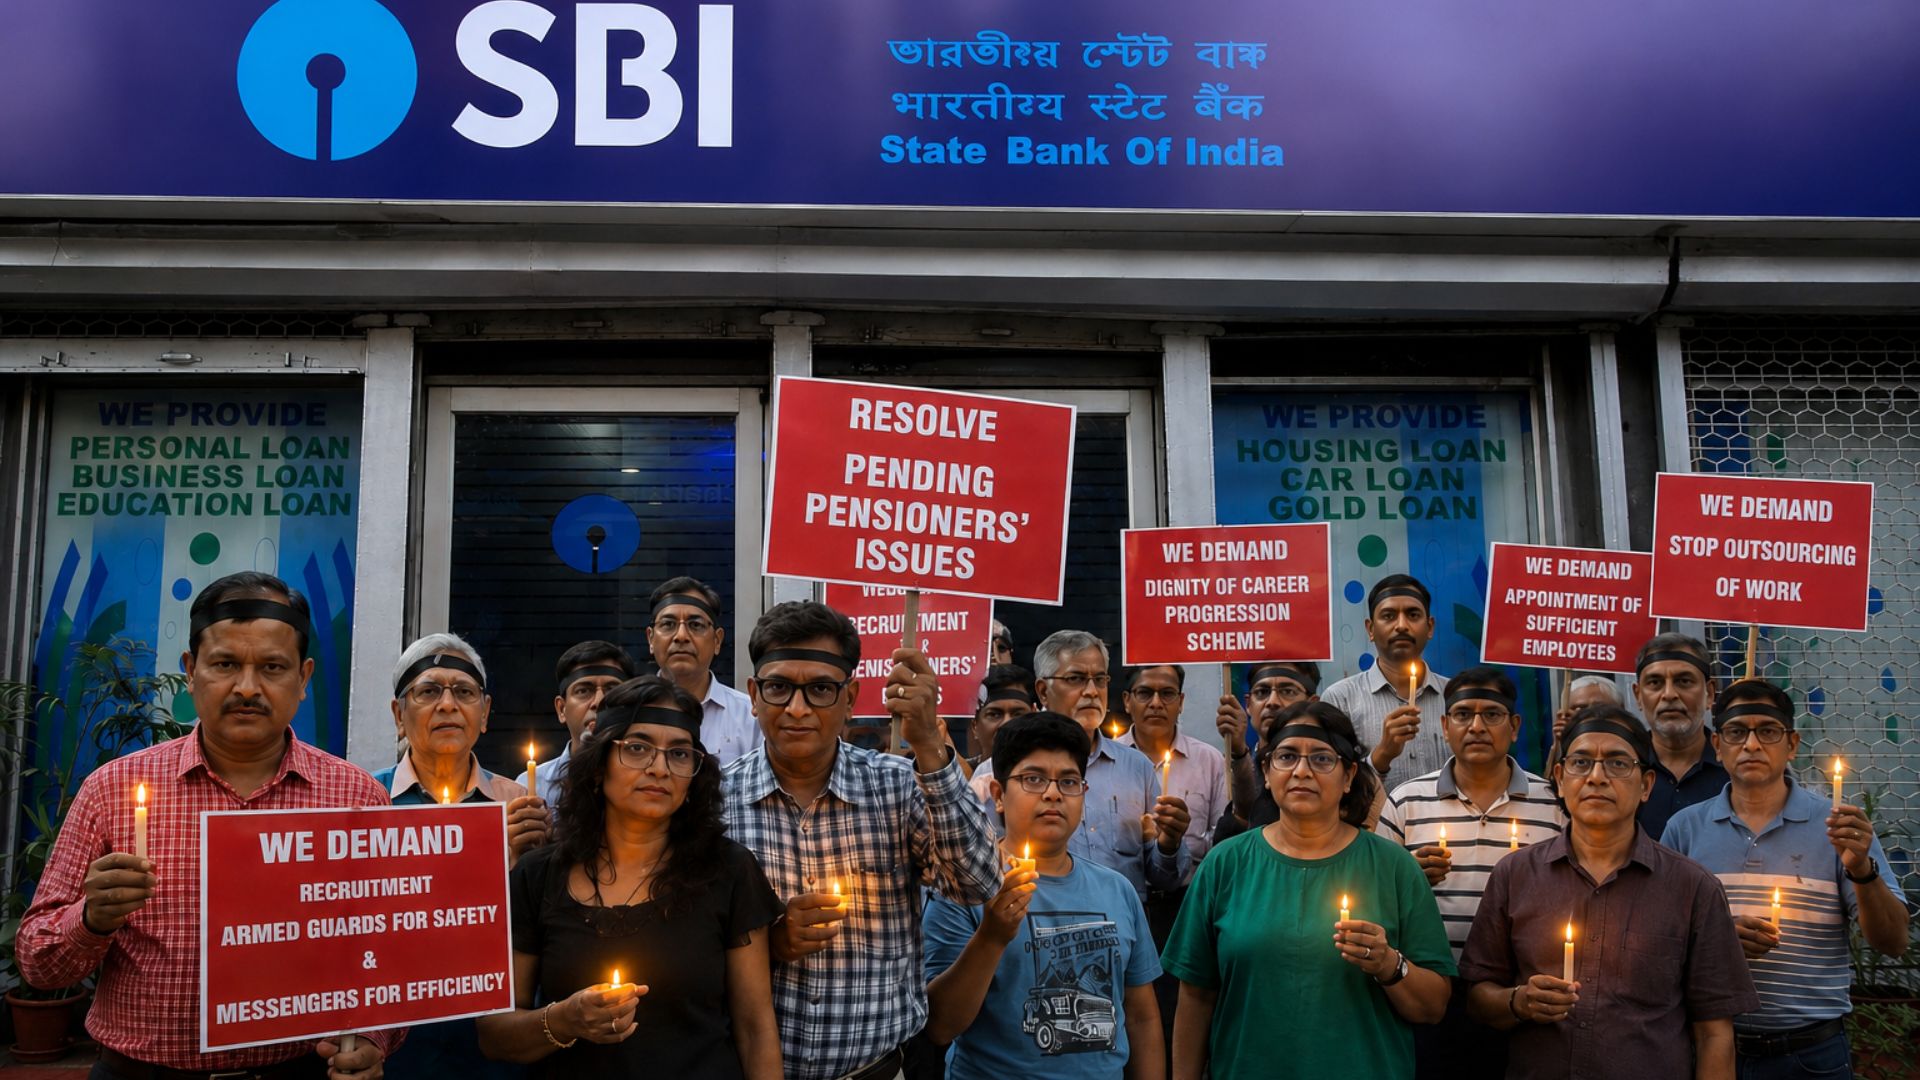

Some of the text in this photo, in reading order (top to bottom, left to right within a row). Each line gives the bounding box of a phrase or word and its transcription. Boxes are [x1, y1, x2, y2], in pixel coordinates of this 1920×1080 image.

[452, 0, 734, 148] SBI
[881, 136, 1283, 165] State Bank Of India
[99, 403, 326, 425] WE PROVIDE
[849, 397, 998, 442] RESOLVE
[1263, 405, 1487, 428] WE PROVIDE
[70, 437, 349, 459] PERSONAL LOAN
[1237, 439, 1506, 463] HOUSING LOAN
[72, 465, 344, 488] BUSINESS LOAN
[844, 453, 995, 498] PENDING
[1280, 467, 1464, 491] CAR LOAN
[57, 493, 350, 516] EDUCATION LOAN
[1268, 496, 1477, 520] GOLD LOAN
[1700, 494, 1832, 522] WE DEMAND
[805, 492, 1030, 544] PENSIONERS'
[855, 537, 976, 579] ISSUES
[1162, 540, 1287, 562] WE DEMAND
[1670, 535, 1856, 566] STOP OUTSOURCING
[1526, 557, 1632, 580] WE DEMAND
[1145, 575, 1309, 596] DIGNITY OF CAREER
[1716, 577, 1802, 601] OF WORK
[1166, 603, 1290, 623] PROGRESSION
[1505, 589, 1642, 613] APPOINTMENT OF
[1526, 615, 1618, 636] SUFFICIENT
[1187, 631, 1265, 651] SCHEME
[1523, 639, 1615, 661] EMPLOYEES
[259, 825, 463, 863] WE DEMAND
[300, 876, 432, 901] RECRUITMENT
[221, 905, 497, 946] ARMED GUARDS FOR SAFETY
[363, 951, 376, 969] &
[217, 972, 504, 1024] MESSENGERS FOR EFFICIENCY
